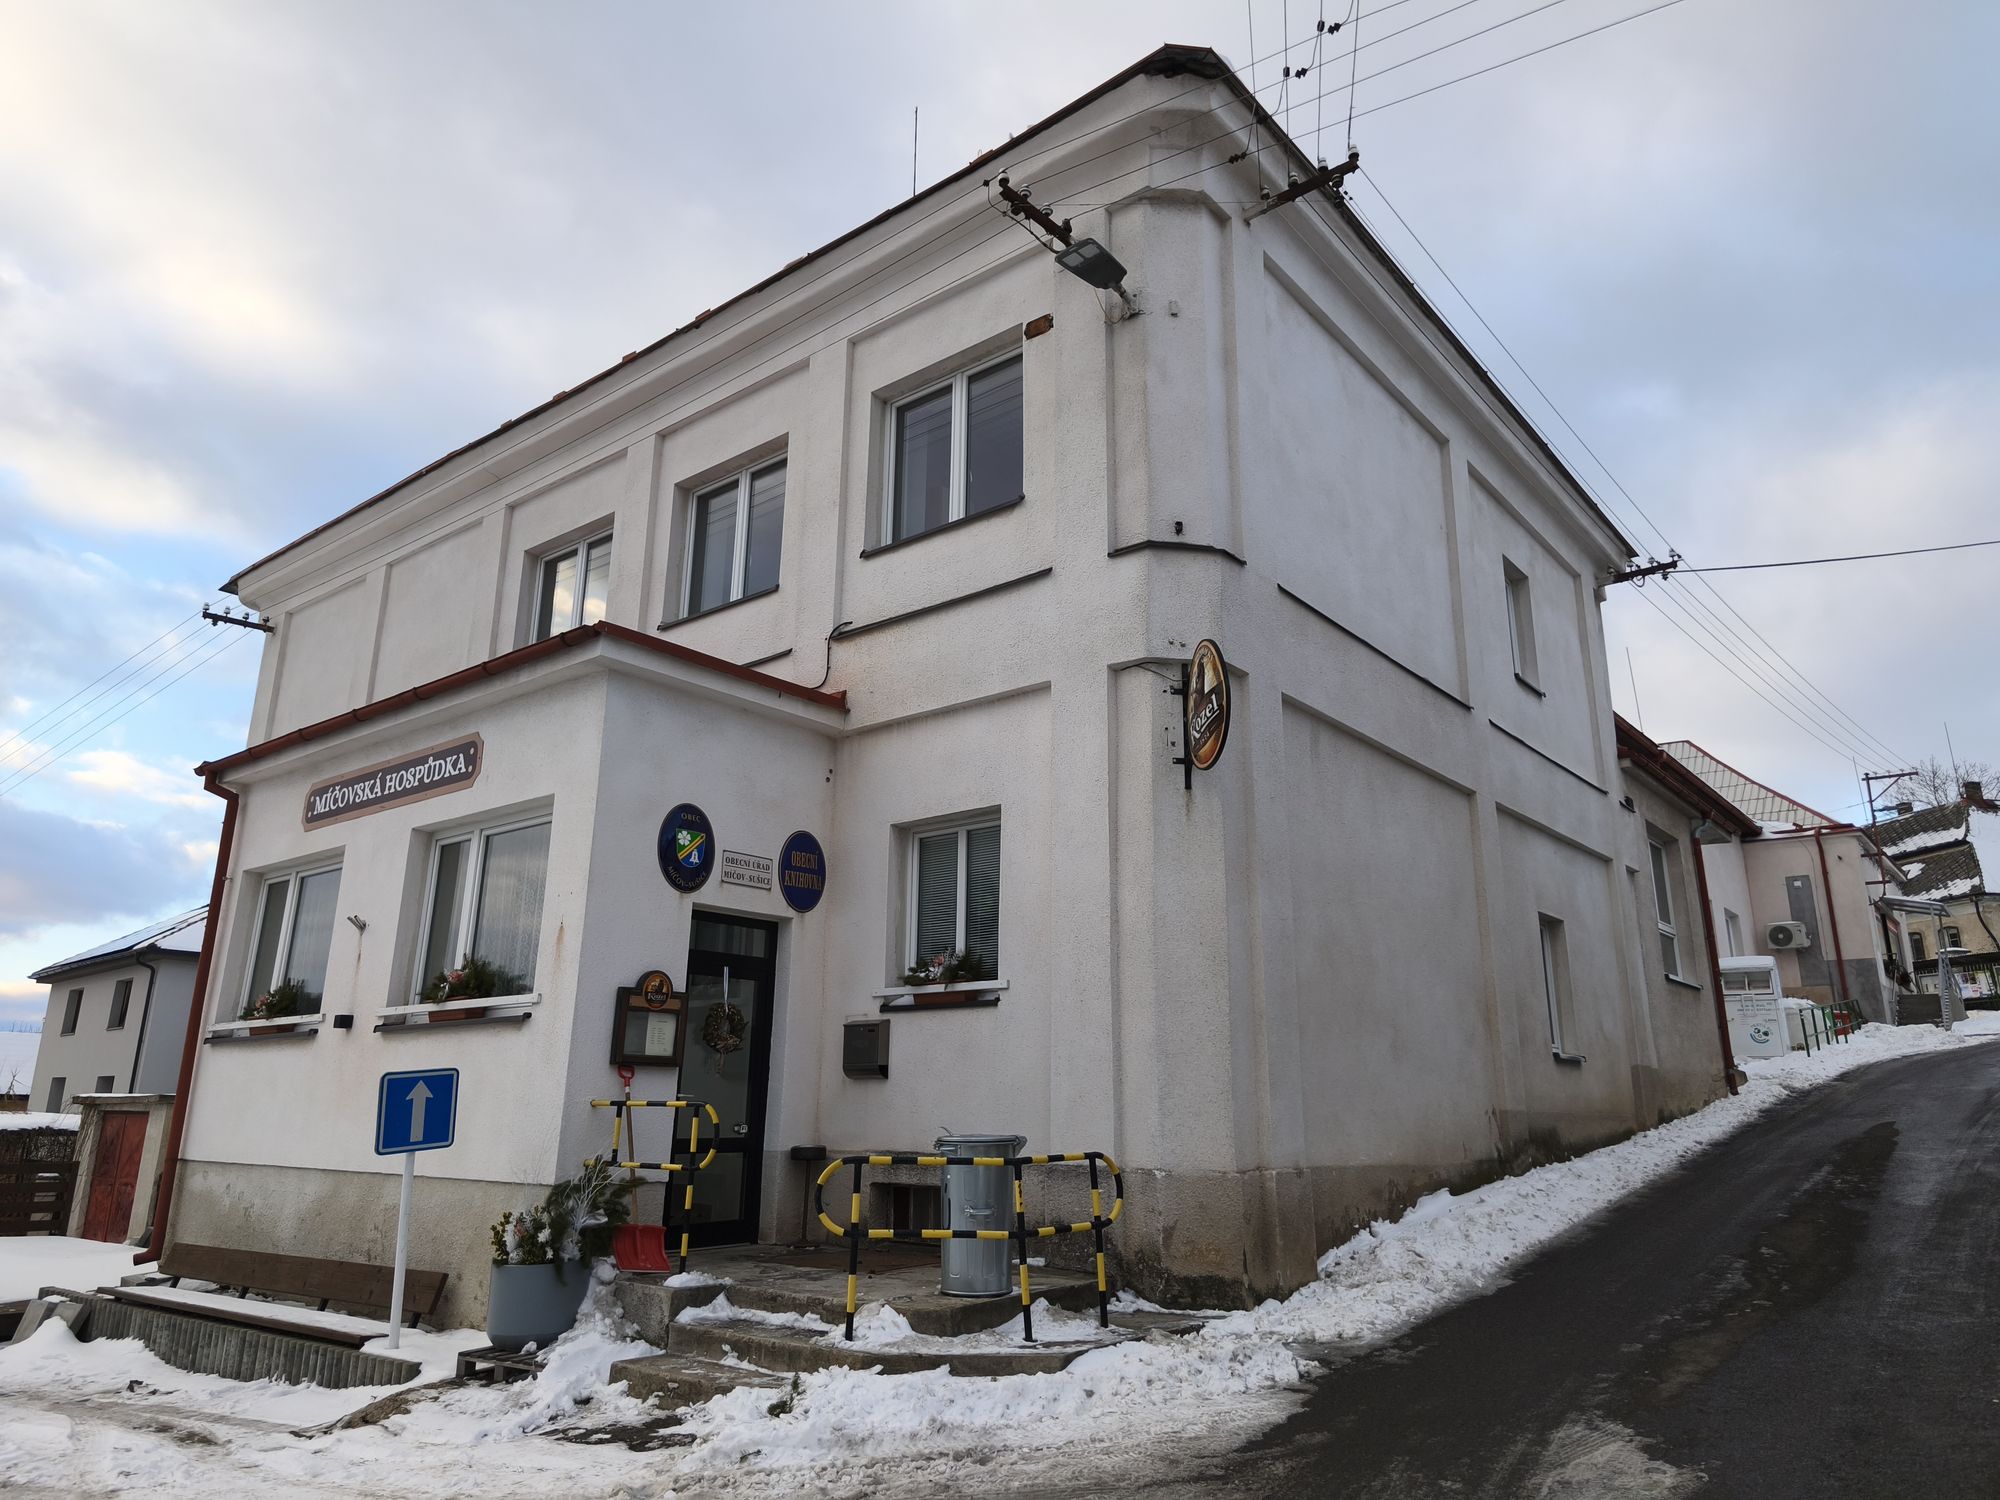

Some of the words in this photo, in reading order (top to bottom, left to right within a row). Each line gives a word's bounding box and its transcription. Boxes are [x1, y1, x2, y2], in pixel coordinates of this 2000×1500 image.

[313, 772, 382, 815] MÍČOVSKÁ
[384, 753, 467, 795] HOSPŮDKA
[681, 812, 701, 823] OBEC
[725, 856, 751, 868] OBECNÍ
[752, 859, 771, 872] ÚŘAD
[791, 850, 818, 870] OBECNÍ
[784, 870, 822, 891] KNIHOVNA
